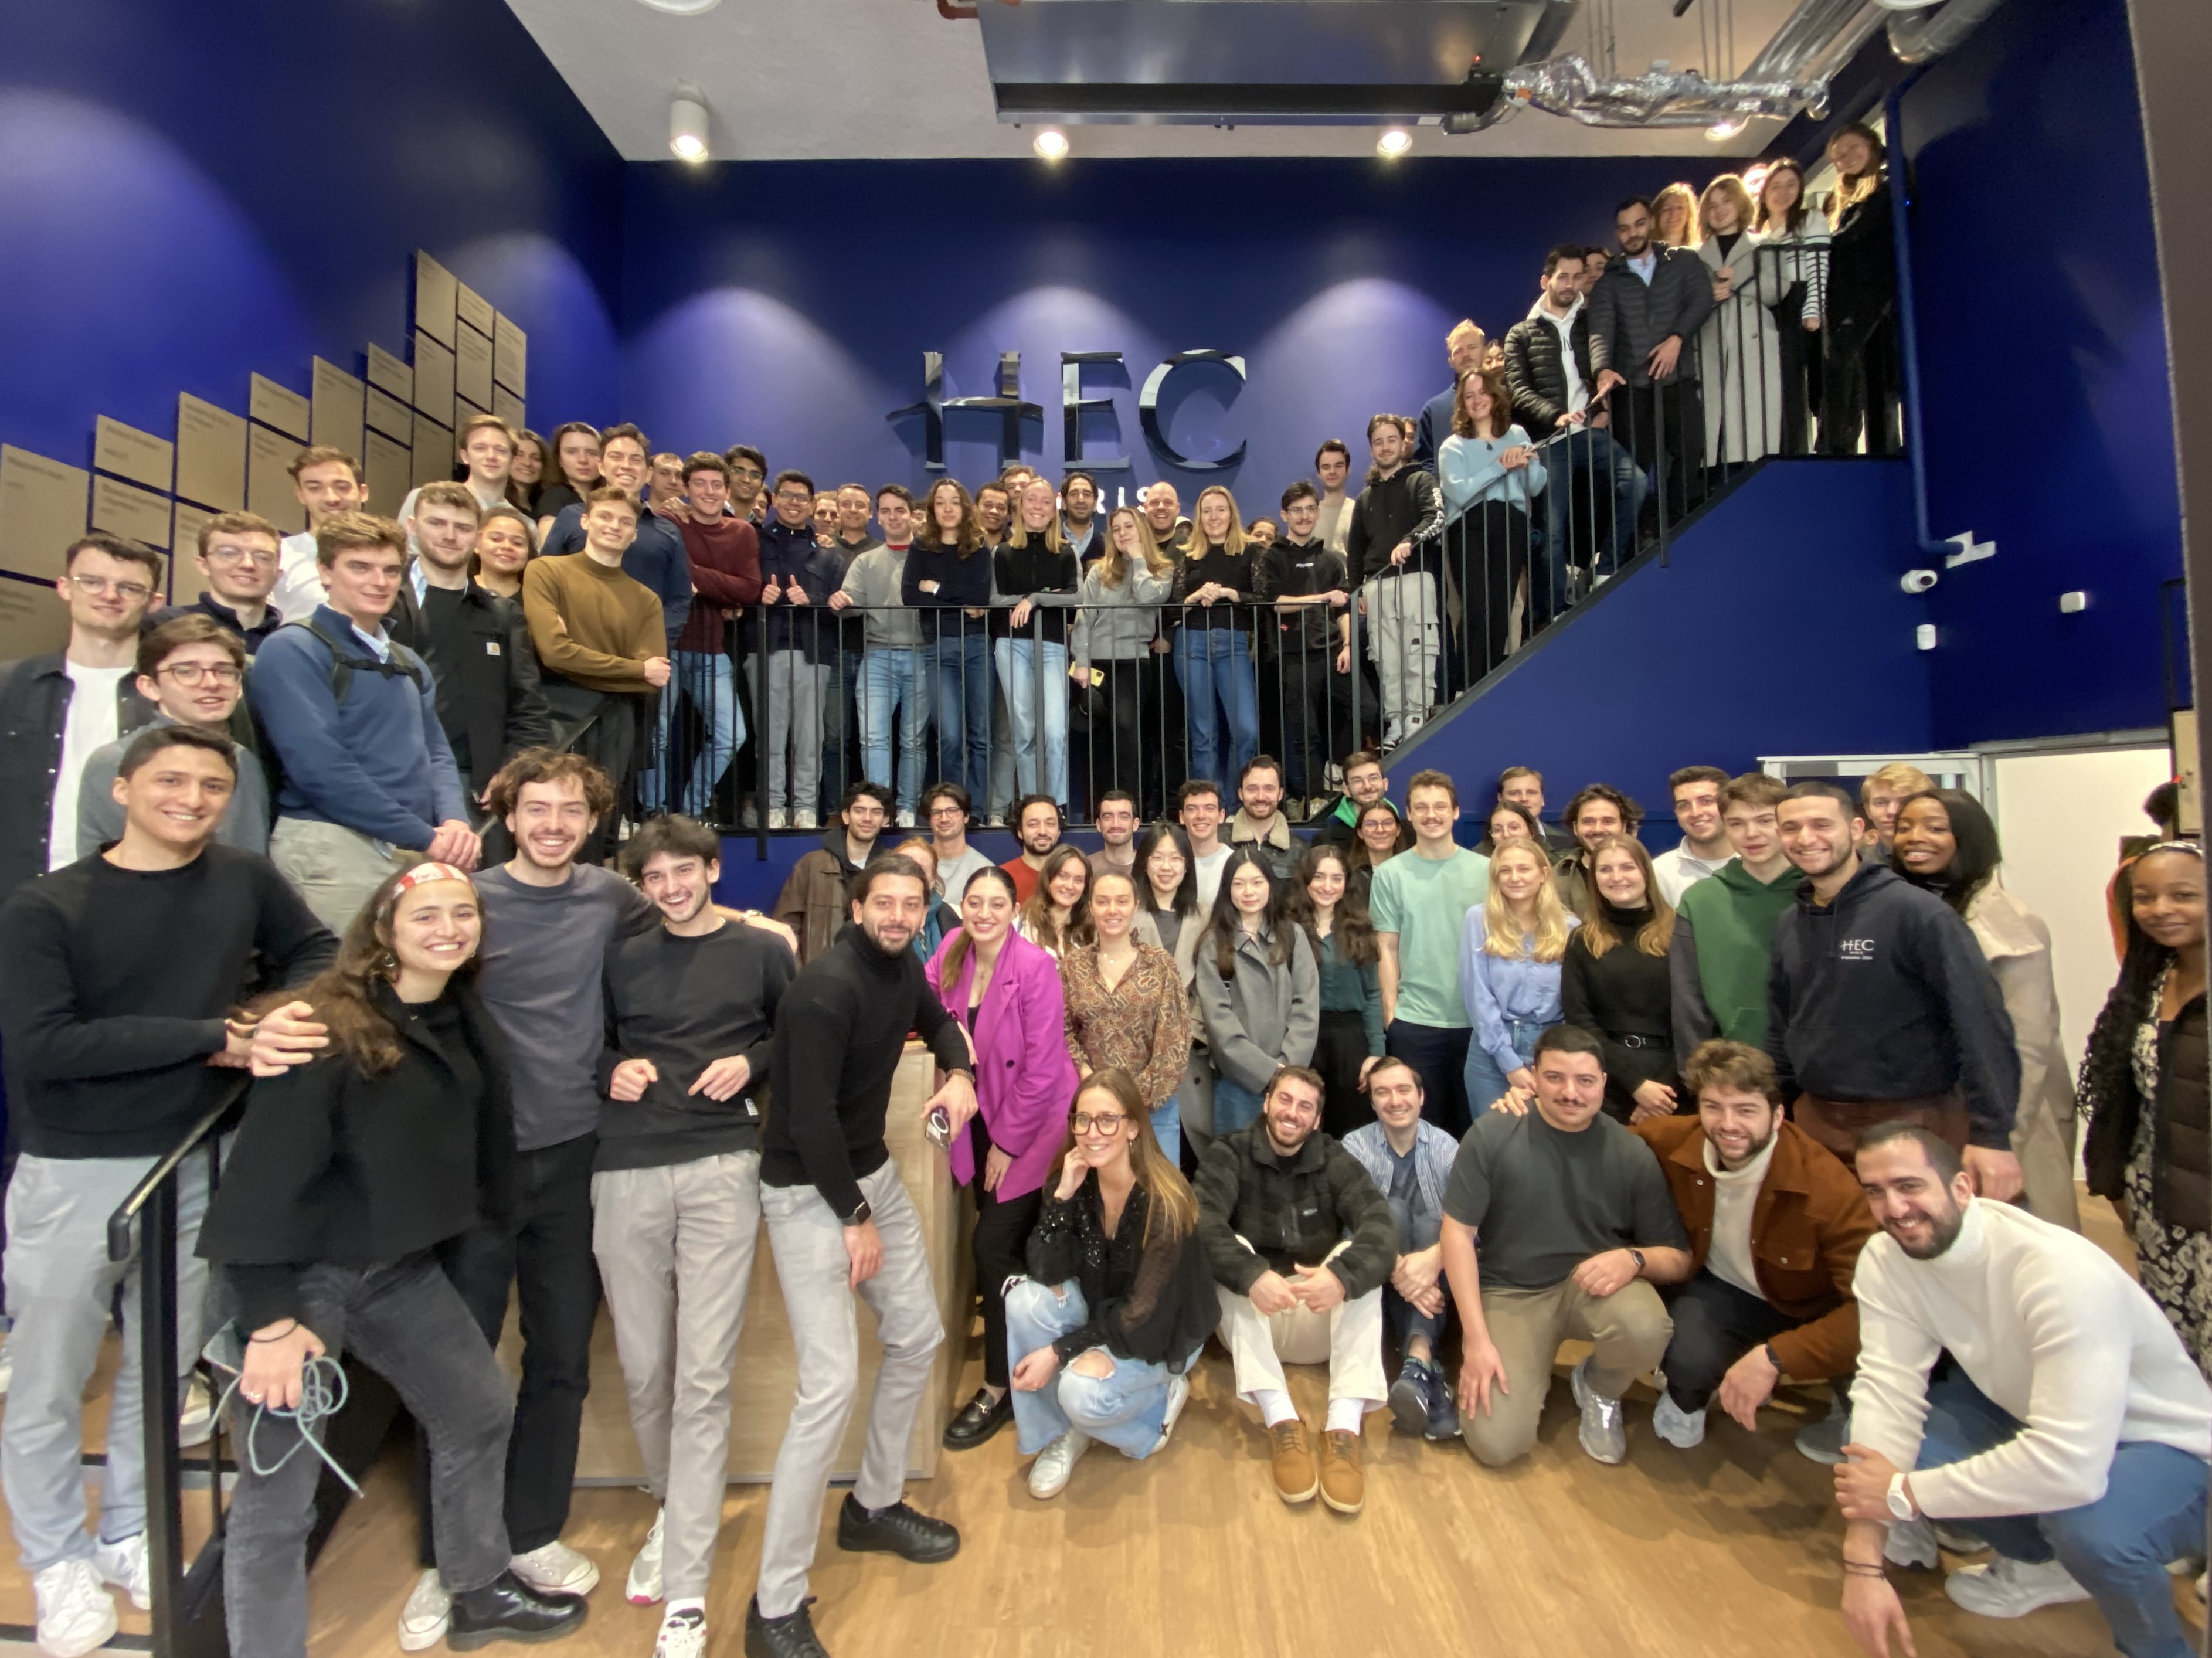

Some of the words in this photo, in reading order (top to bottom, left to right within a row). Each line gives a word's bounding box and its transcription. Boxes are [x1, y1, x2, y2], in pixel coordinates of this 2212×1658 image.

[886, 349, 1247, 470] HEC
[1056, 486, 1151, 514] RIS
[1840, 939, 1875, 951] HEC
